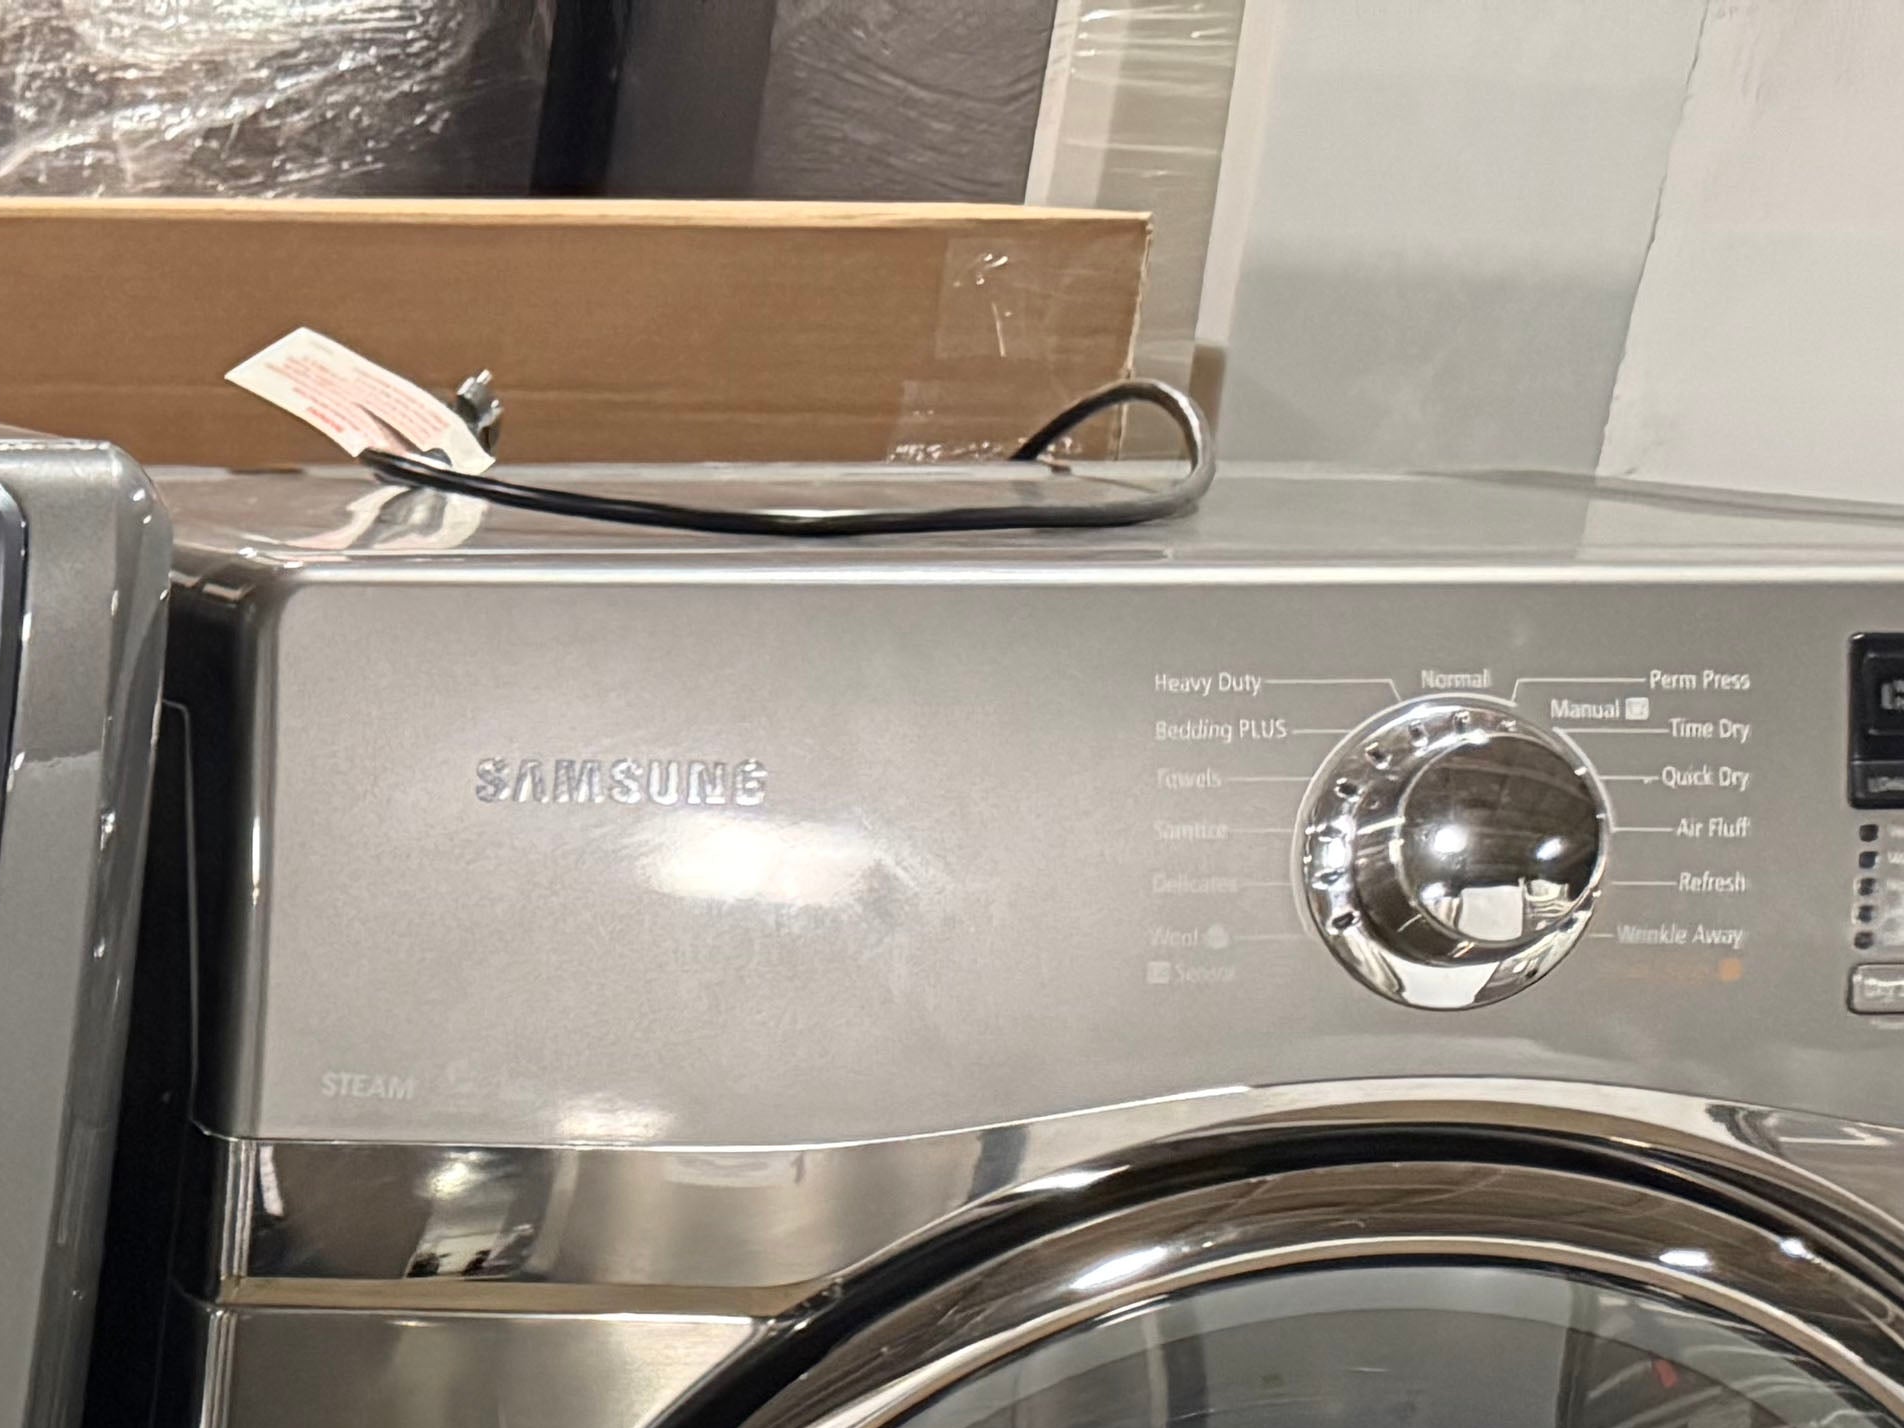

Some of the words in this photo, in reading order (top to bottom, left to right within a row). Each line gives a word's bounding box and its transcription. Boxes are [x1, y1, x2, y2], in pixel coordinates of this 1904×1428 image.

[1155, 674, 1213, 695] Heavy
[1218, 672, 1262, 694] Duty
[1421, 669, 1490, 689] Normal
[1649, 671, 1697, 690] Perm
[1702, 671, 1751, 690] Press
[1550, 699, 1620, 719] Manual
[1155, 721, 1233, 743] Bedding
[1239, 719, 1289, 739] PLUS
[1669, 718, 1714, 738] Time
[1719, 718, 1751, 744] Dry
[1157, 768, 1223, 790] Towels
[1661, 766, 1712, 787] Quick
[1719, 766, 1751, 791] Dry
[1676, 818, 1704, 837] Air
[1708, 817, 1750, 837] Fluff
[1678, 872, 1746, 891] Refresh
[1616, 923, 1689, 945] Wrinkle
[1692, 923, 1744, 949] Away
[321, 1071, 416, 1100] STEAM
